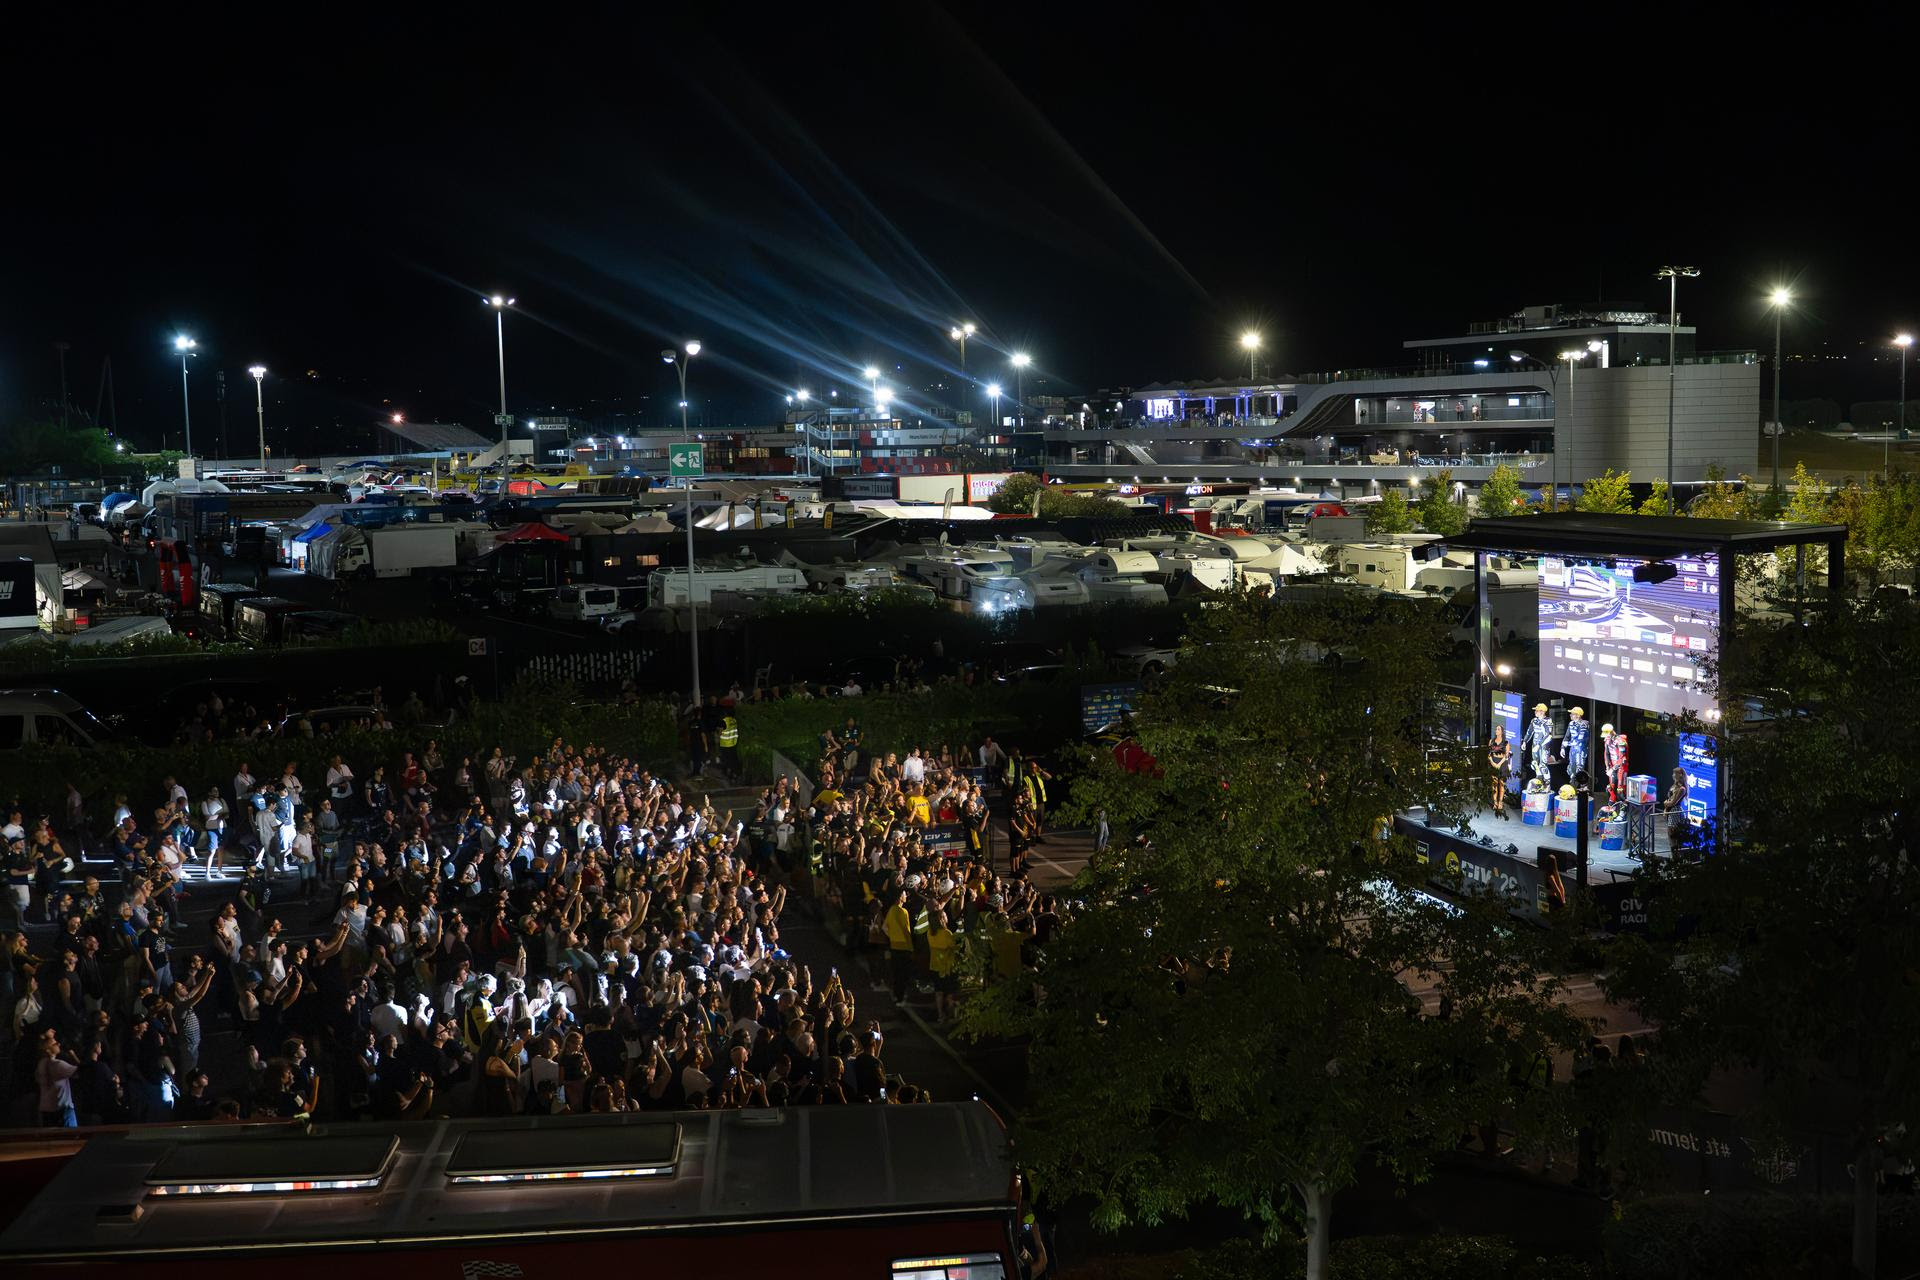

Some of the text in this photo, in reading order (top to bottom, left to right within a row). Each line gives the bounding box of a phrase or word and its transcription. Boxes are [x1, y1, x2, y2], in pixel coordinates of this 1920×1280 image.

[1120, 485, 1139, 494] ACTON
[1186, 485, 1212, 495] ACTON
[470, 641, 485, 653] C4
[1557, 809, 1571, 818] Bull
[1461, 860, 1492, 885] CIV
[1620, 898, 1643, 911] CIV
[1620, 913, 1647, 925] RACI
